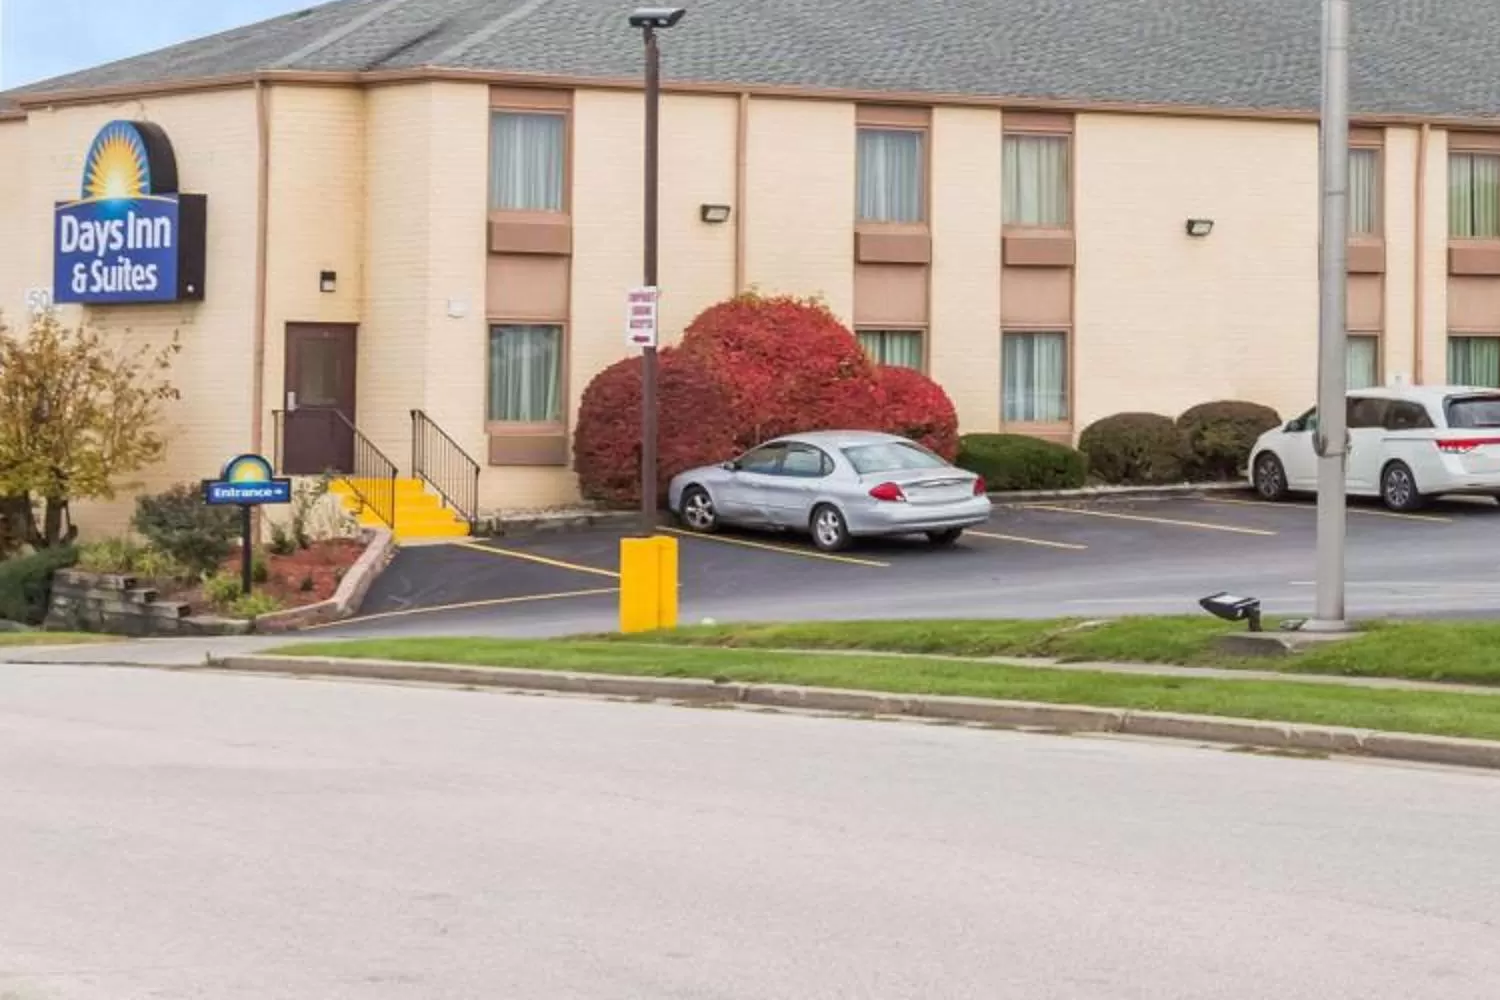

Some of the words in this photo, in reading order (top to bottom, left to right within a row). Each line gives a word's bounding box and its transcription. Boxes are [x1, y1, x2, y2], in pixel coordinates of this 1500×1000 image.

[61, 215, 123, 257] Days
[127, 211, 171, 249] Inn
[72, 262, 88, 294] &
[90, 255, 158, 292] Suites
[214, 487, 272, 498] Entrance
